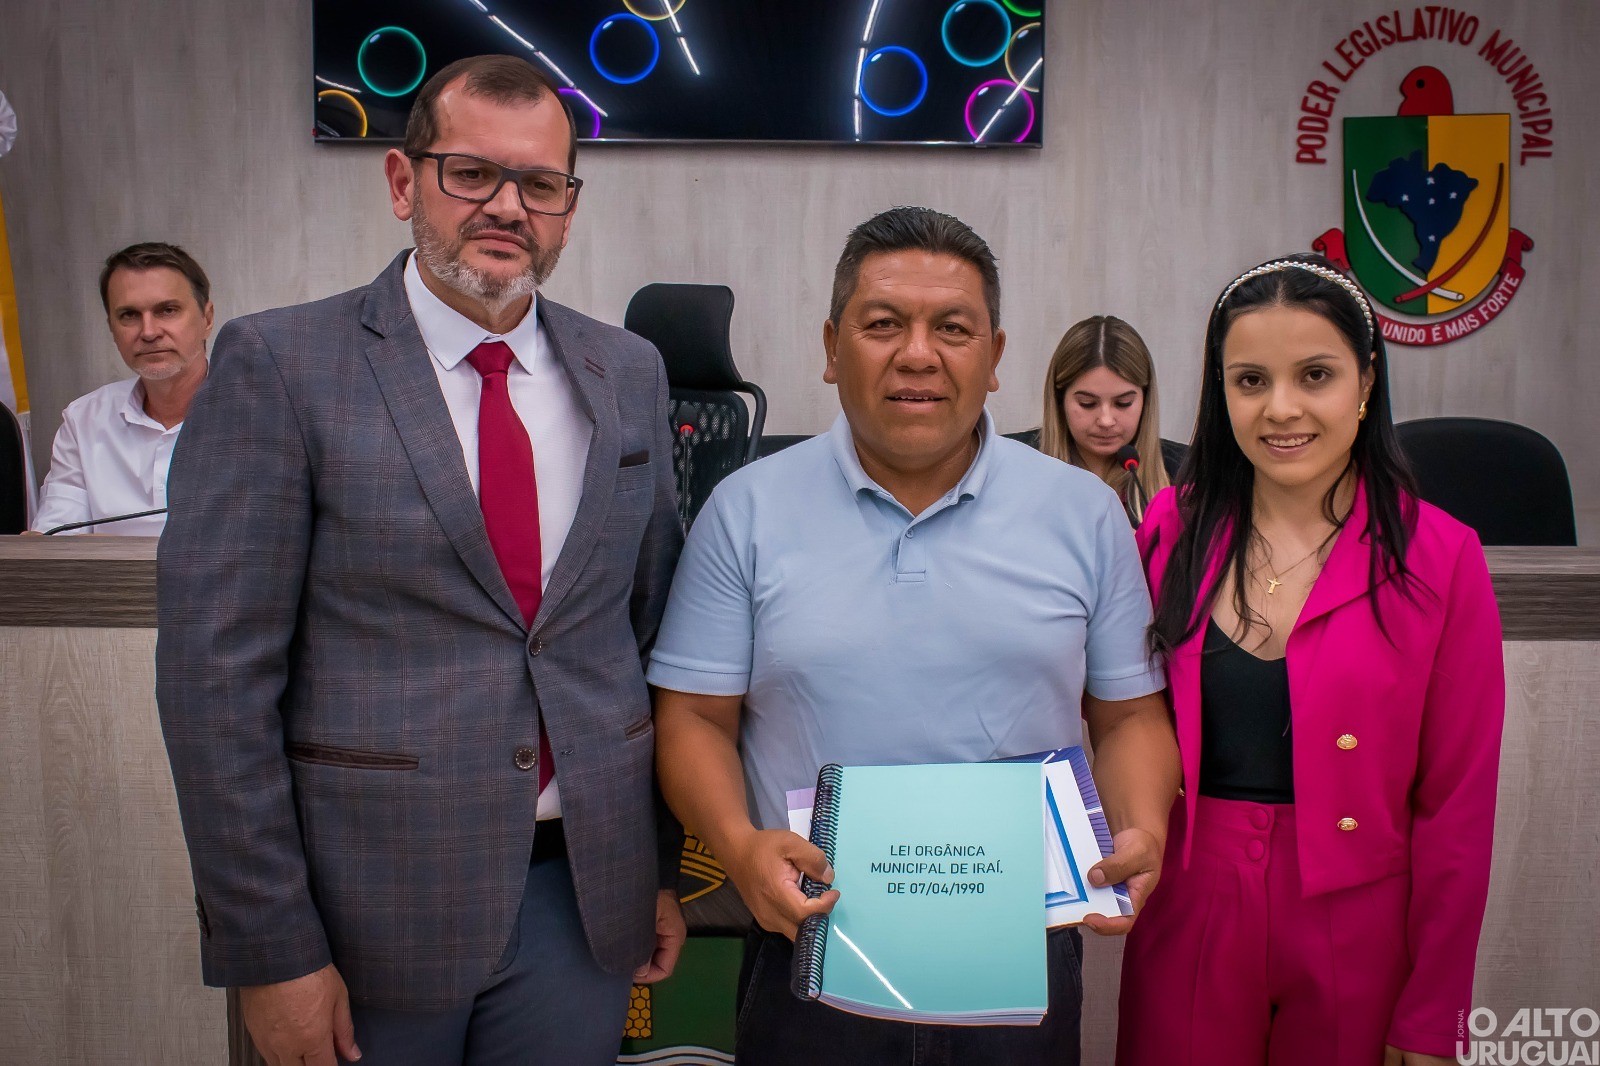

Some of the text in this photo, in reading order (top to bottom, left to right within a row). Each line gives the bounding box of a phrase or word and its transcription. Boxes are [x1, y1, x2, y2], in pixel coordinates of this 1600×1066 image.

[1296, 6, 1553, 166] PODER LEGISLATIVO MUNICIPAL
[1382, 272, 1520, 343] UNIDO É MAIS FORTE
[890, 843, 985, 857] LEI ORGÂNICA
[871, 861, 946, 874] MUNICIPAL
[950, 862, 968, 874] DE
[887, 882, 985, 895] DE 07/04/1990
